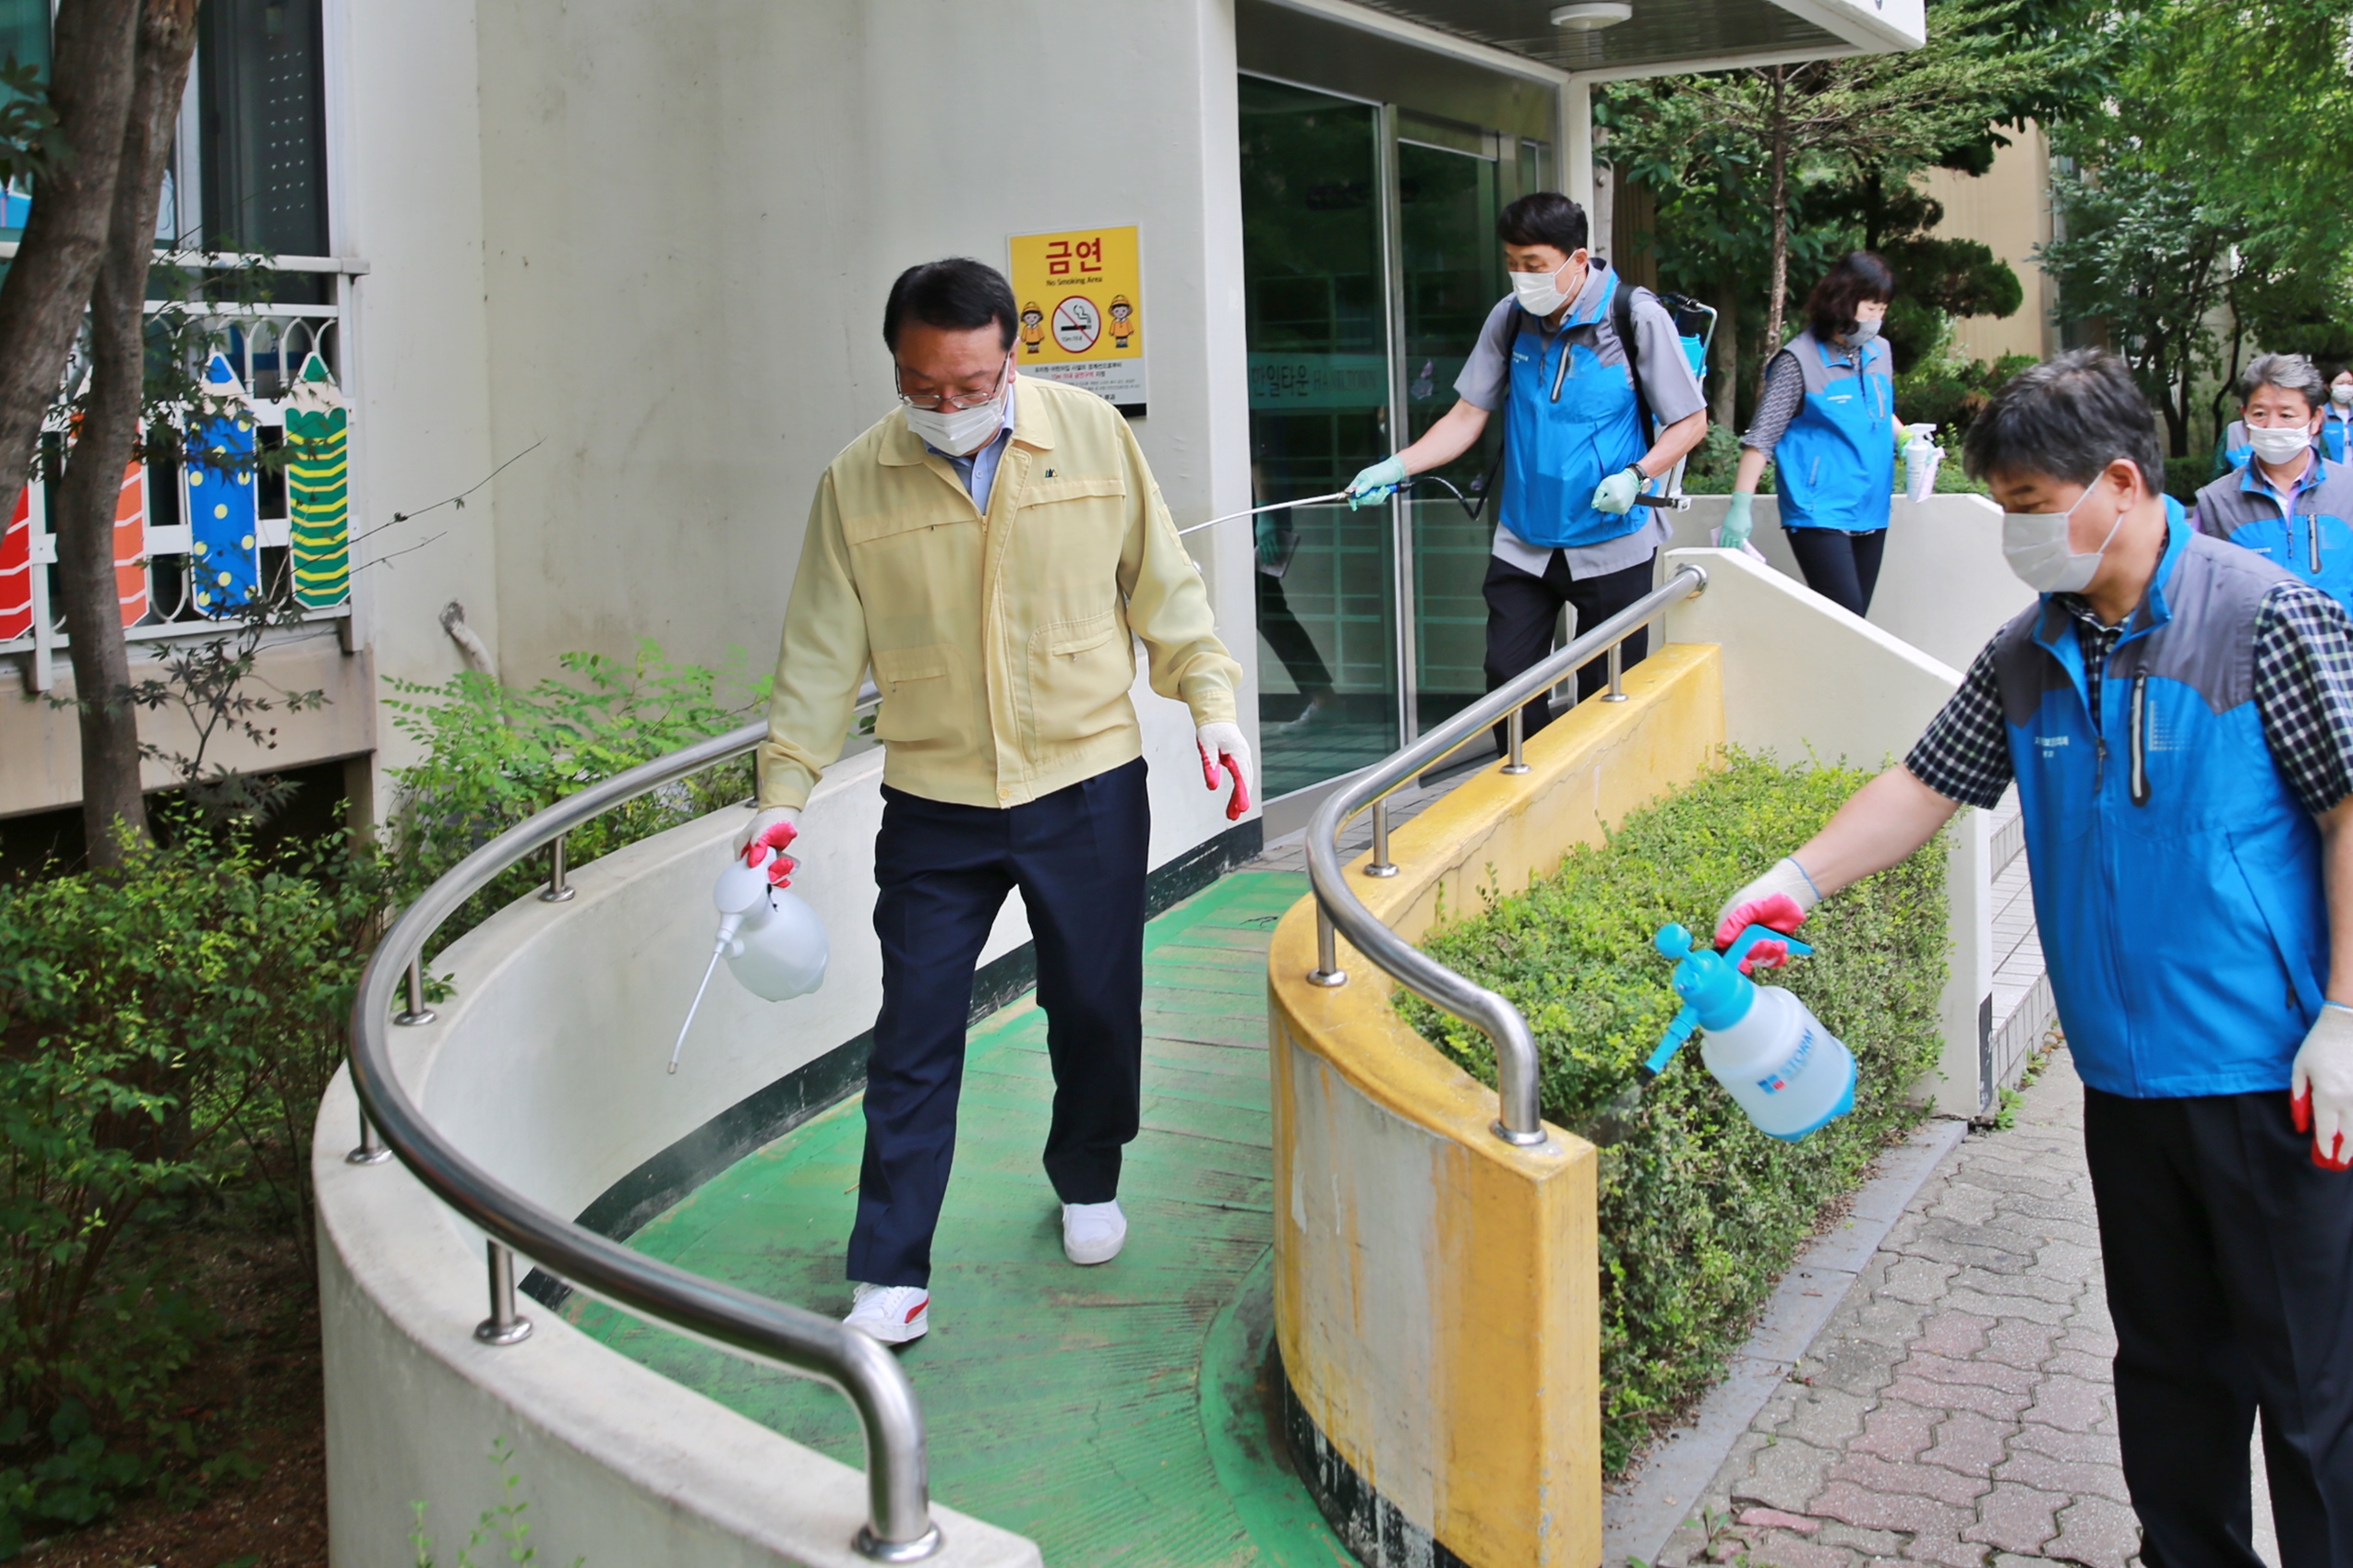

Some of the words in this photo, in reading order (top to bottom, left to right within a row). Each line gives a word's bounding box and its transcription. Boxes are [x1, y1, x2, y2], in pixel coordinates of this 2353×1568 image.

[1046, 237, 1102, 275] 금연
[1057, 277, 1086, 286] Smoking
[1087, 276, 1103, 284] Area
